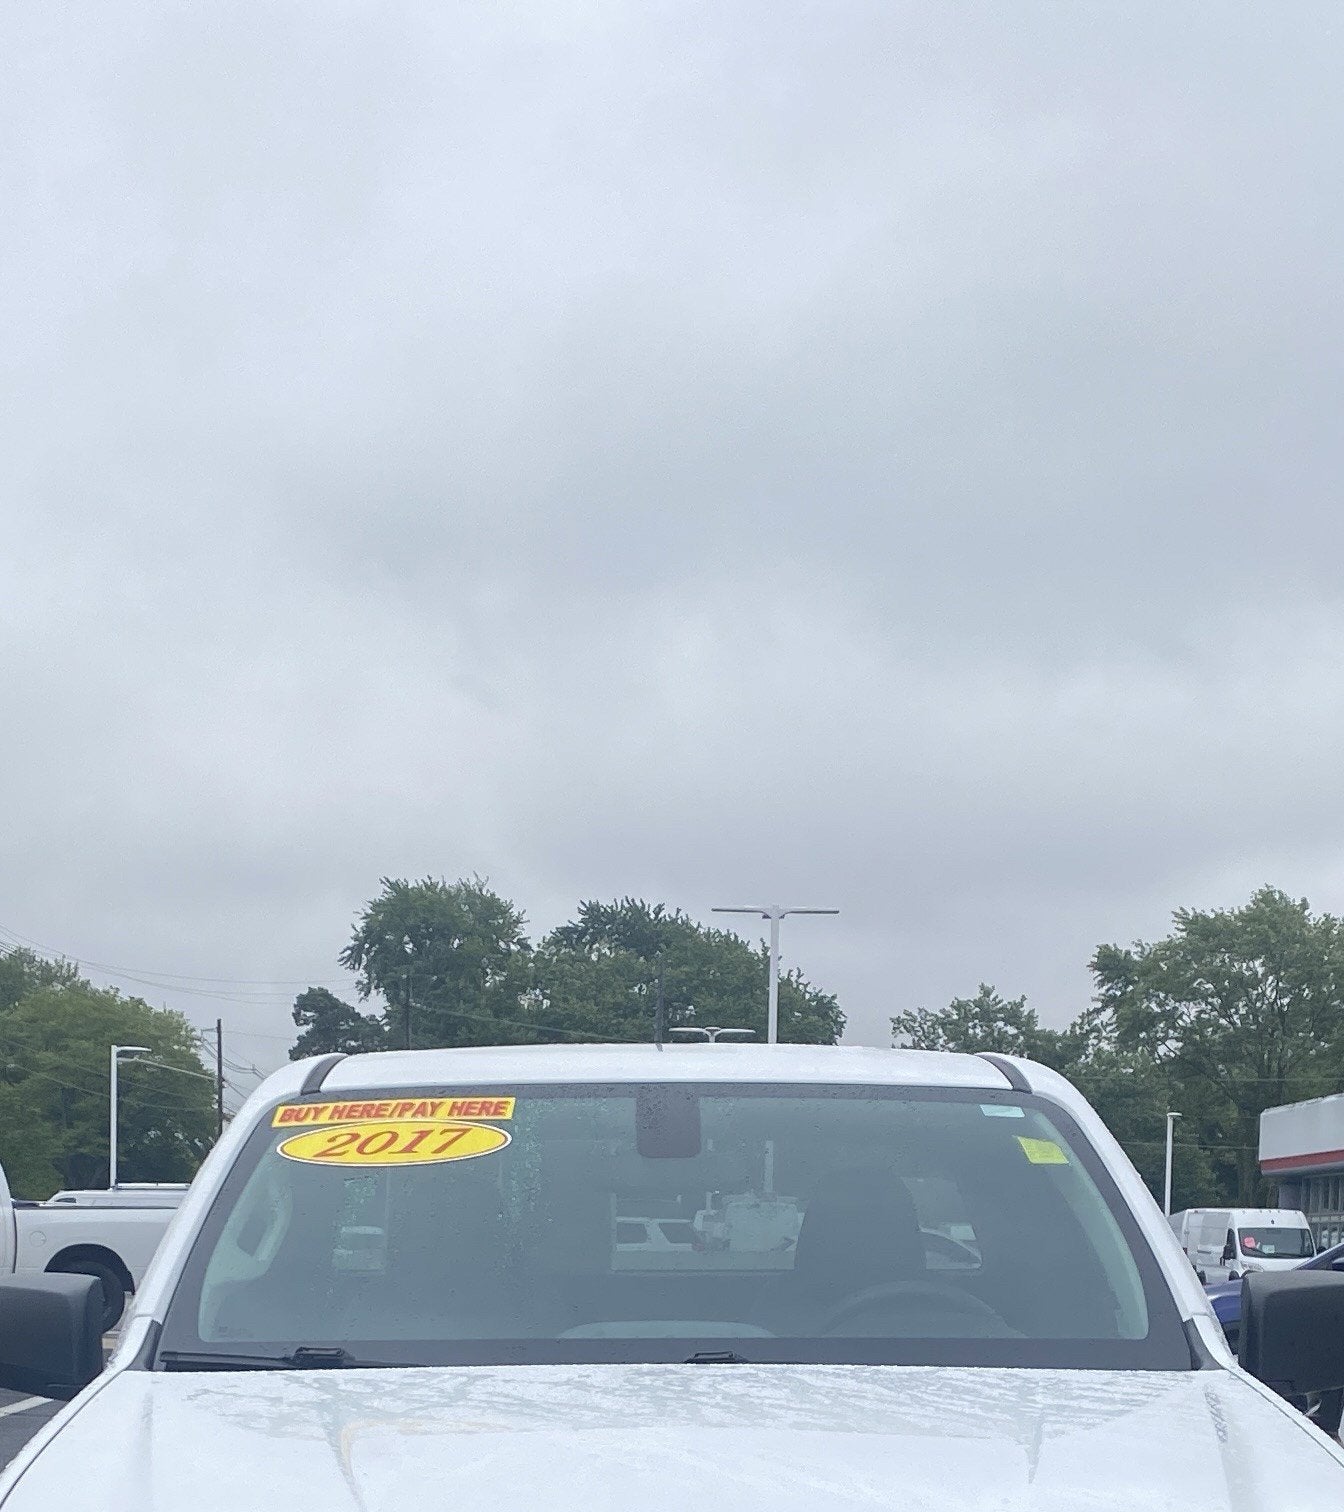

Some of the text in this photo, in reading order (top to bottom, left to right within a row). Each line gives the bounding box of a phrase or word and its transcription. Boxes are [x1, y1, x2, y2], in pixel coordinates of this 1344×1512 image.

[278, 1099, 511, 1123] BUY HERE/PAY HERE
[312, 1127, 473, 1158] 2017
